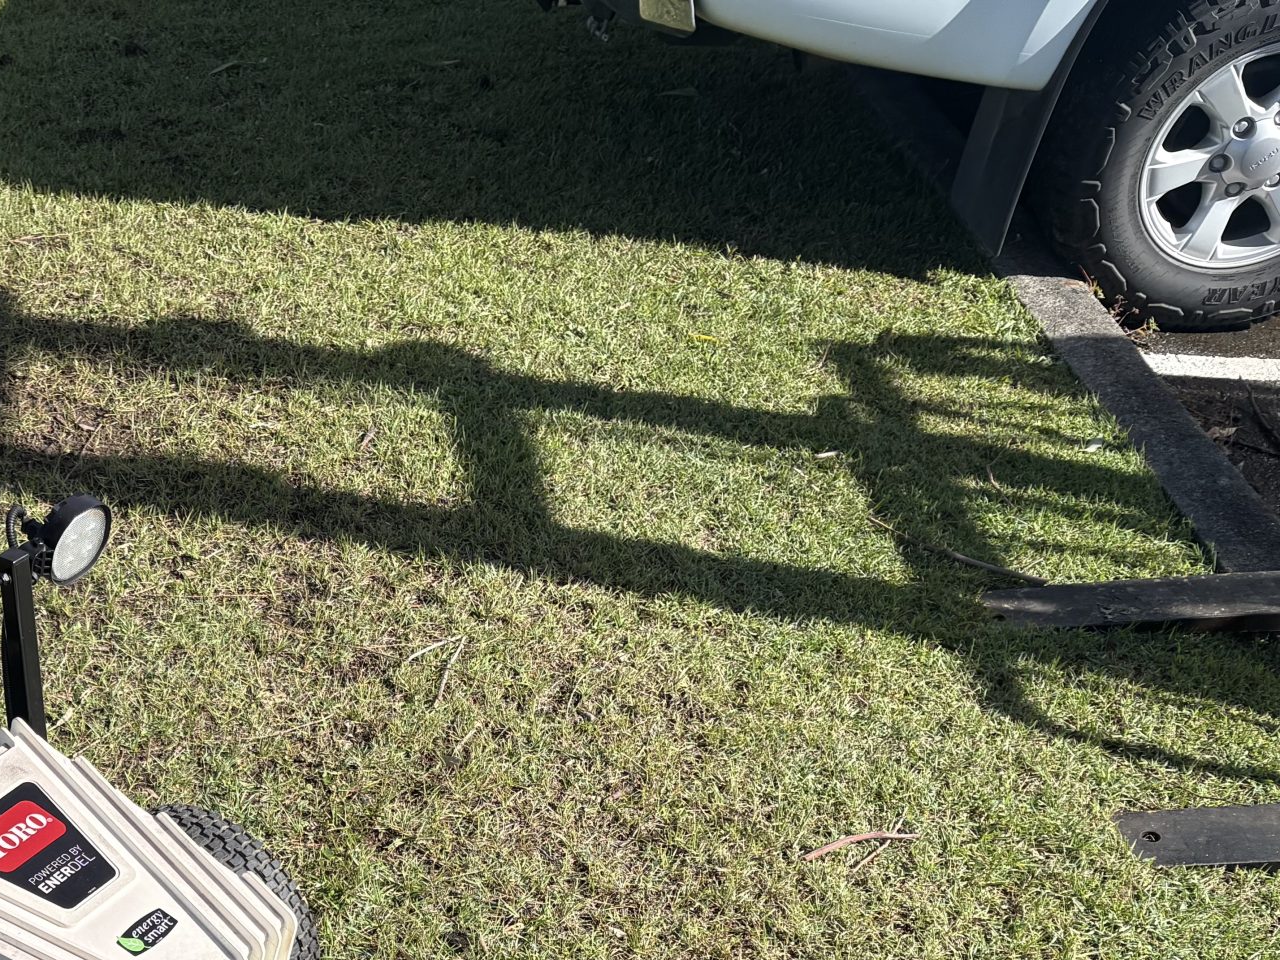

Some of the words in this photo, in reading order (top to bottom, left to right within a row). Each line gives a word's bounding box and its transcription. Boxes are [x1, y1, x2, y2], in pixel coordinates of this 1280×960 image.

[28, 853, 71, 886] POWERED
[68, 844, 82, 856] BY
[37, 852, 97, 895] ENERDEL
[132, 910, 164, 938] energy
[144, 918, 174, 943] smart
